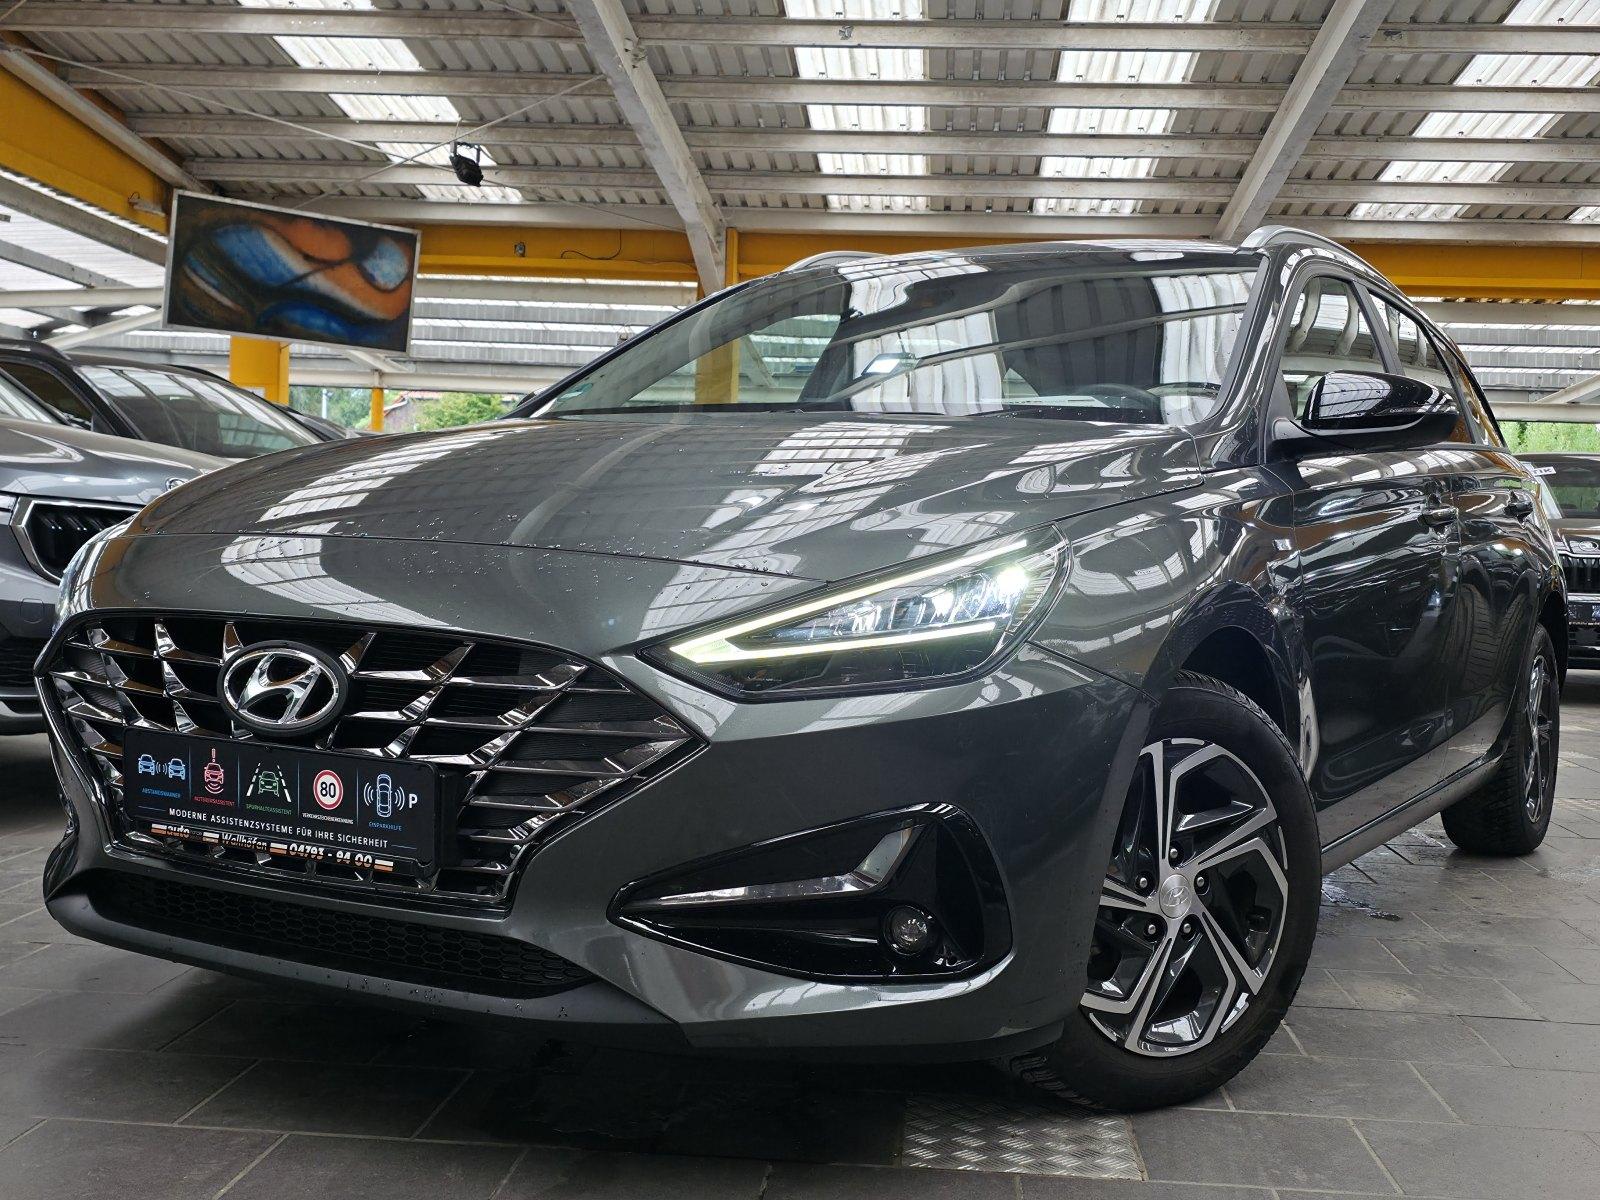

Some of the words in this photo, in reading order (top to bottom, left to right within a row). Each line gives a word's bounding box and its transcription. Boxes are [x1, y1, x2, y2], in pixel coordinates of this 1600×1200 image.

[320, 781, 337, 798] 80
[408, 793, 418, 809] P
[169, 808, 207, 821] MODERNE
[210, 814, 293, 835] ASSISTENZSYSTEME
[296, 826, 312, 838] FÜR
[315, 829, 334, 841] IHRE
[337, 833, 388, 849] SICHERHEIT
[354, 853, 373, 868] 00
